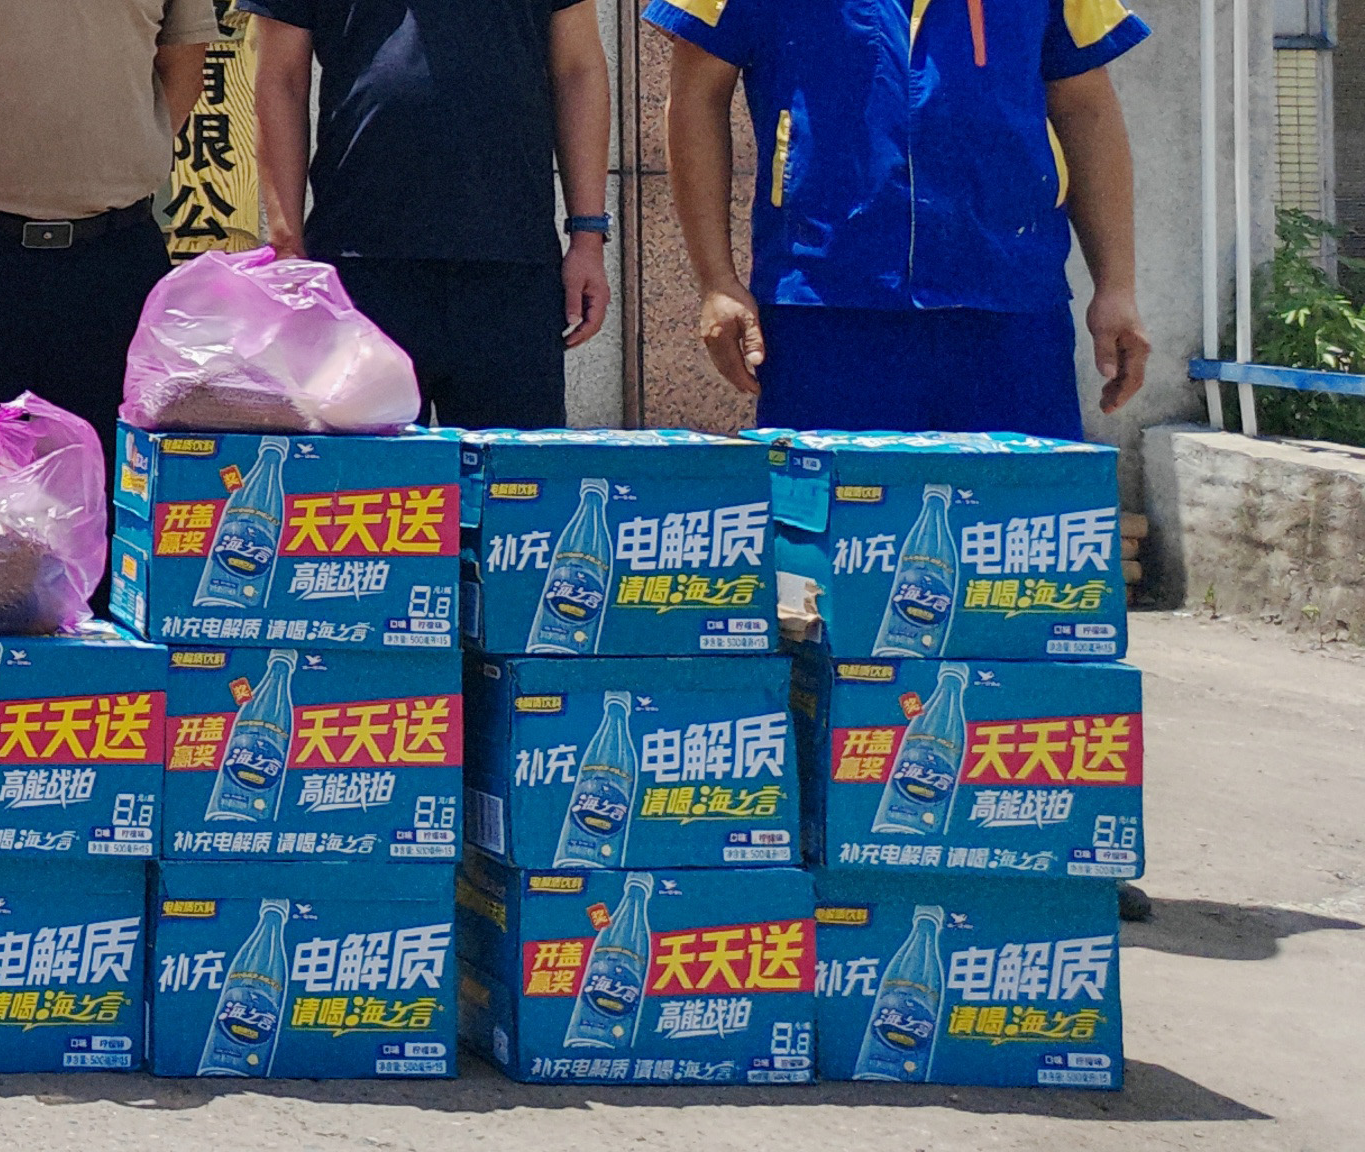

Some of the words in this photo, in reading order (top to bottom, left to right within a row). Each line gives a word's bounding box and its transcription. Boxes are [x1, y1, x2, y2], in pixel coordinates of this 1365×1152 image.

[164, 504, 215, 530] 开盖
[285, 488, 445, 553] 天天送
[157, 532, 204, 555] 赢奖
[486, 531, 551, 573] 补充
[616, 501, 770, 571] 电解质
[834, 534, 896, 574] 补充
[960, 506, 1117, 574] 电解质
[287, 560, 390, 595] 高能战拍
[161, 617, 262, 641] 补充电解质
[176, 717, 226, 745] 开盖
[296, 698, 450, 763] 天天送
[844, 730, 896, 755] 开盖
[169, 745, 217, 768] 赢奖
[515, 744, 577, 787] 补充
[641, 712, 788, 783] 电解质
[967, 716, 1129, 781] 天天送
[296, 771, 396, 805] 高能战拍
[969, 790, 1074, 823] 高能战拍
[173, 831, 272, 853] 补充电解质
[158, 950, 226, 993] 补充
[291, 923, 453, 992] 电解质
[533, 942, 584, 970] 开盖
[653, 922, 804, 989] 天天送
[814, 957, 880, 997] 补充
[947, 935, 1115, 1001] 电解质
[655, 998, 753, 1033] 高能战拍
